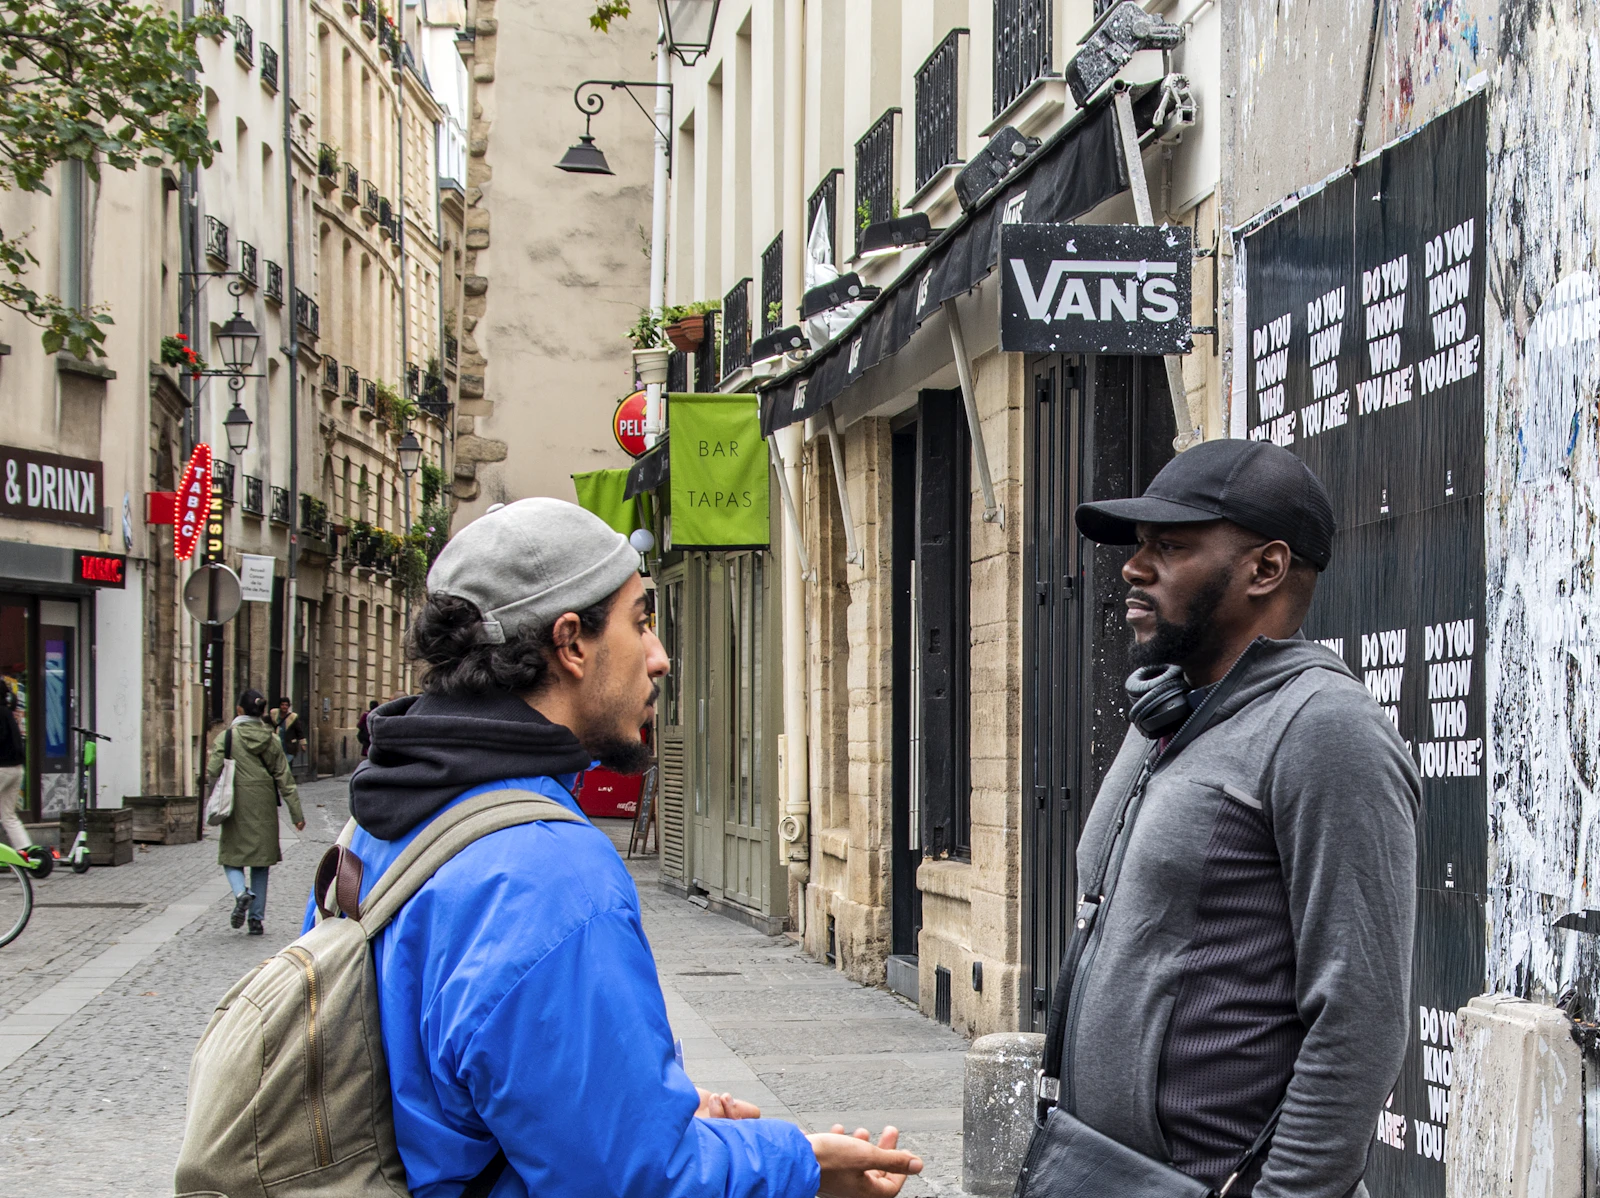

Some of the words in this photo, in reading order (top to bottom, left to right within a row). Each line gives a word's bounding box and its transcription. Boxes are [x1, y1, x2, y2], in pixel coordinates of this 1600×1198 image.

[1425, 235, 1442, 278] DO
[1444, 218, 1474, 266] YOU
[1009, 259, 1179, 322] VANS
[1363, 266, 1381, 305] DO
[1381, 254, 1408, 297] YOU
[1429, 260, 1471, 315] KNOW
[1307, 297, 1322, 334] DO
[1322, 286, 1346, 326] YOU
[1366, 293, 1405, 340] KNOW
[1432, 303, 1466, 351] WHO
[1571, 297, 1600, 345] ARE
[1253, 325, 1268, 359] DO
[1268, 313, 1292, 351] YOU
[1310, 322, 1342, 367] KNOW
[1369, 333, 1401, 375] WHO
[1255, 348, 1289, 391] KNOW
[1312, 360, 1338, 400] WHO
[1418, 351, 1446, 396] YOU
[1445, 334, 1481, 385] ARE?
[1258, 383, 1285, 422] WHO
[1356, 377, 1382, 416] YOU
[1382, 364, 1414, 409] ARE?
[1270, 410, 1297, 447] ARE?
[1301, 400, 1322, 439] YOU
[1322, 389, 1350, 432] ARE?
[699, 440, 739, 457] BAR
[5, 459, 21, 505] &
[27, 462, 95, 515] DRINK
[181, 467, 205, 537] TABAC
[687, 490, 752, 508] TAPAS
[208, 483, 223, 561] 'USINE
[1361, 632, 1379, 668] DO
[1379, 629, 1407, 665] YOU
[1425, 623, 1444, 661] DO
[1445, 619, 1474, 657] YOU
[1365, 667, 1403, 703] KNOW
[1428, 659, 1472, 699] KNOW
[1431, 700, 1467, 738] WHO
[1418, 741, 1446, 778] YOU
[1446, 737, 1483, 777] ARE?
[1419, 1005, 1439, 1045] DO
[1439, 1010, 1457, 1049] YO
[1423, 1045, 1454, 1087] KNO
[1428, 1085, 1450, 1125] WH
[1377, 1110, 1407, 1150] ARE?
[1414, 1119, 1443, 1162] YOU
